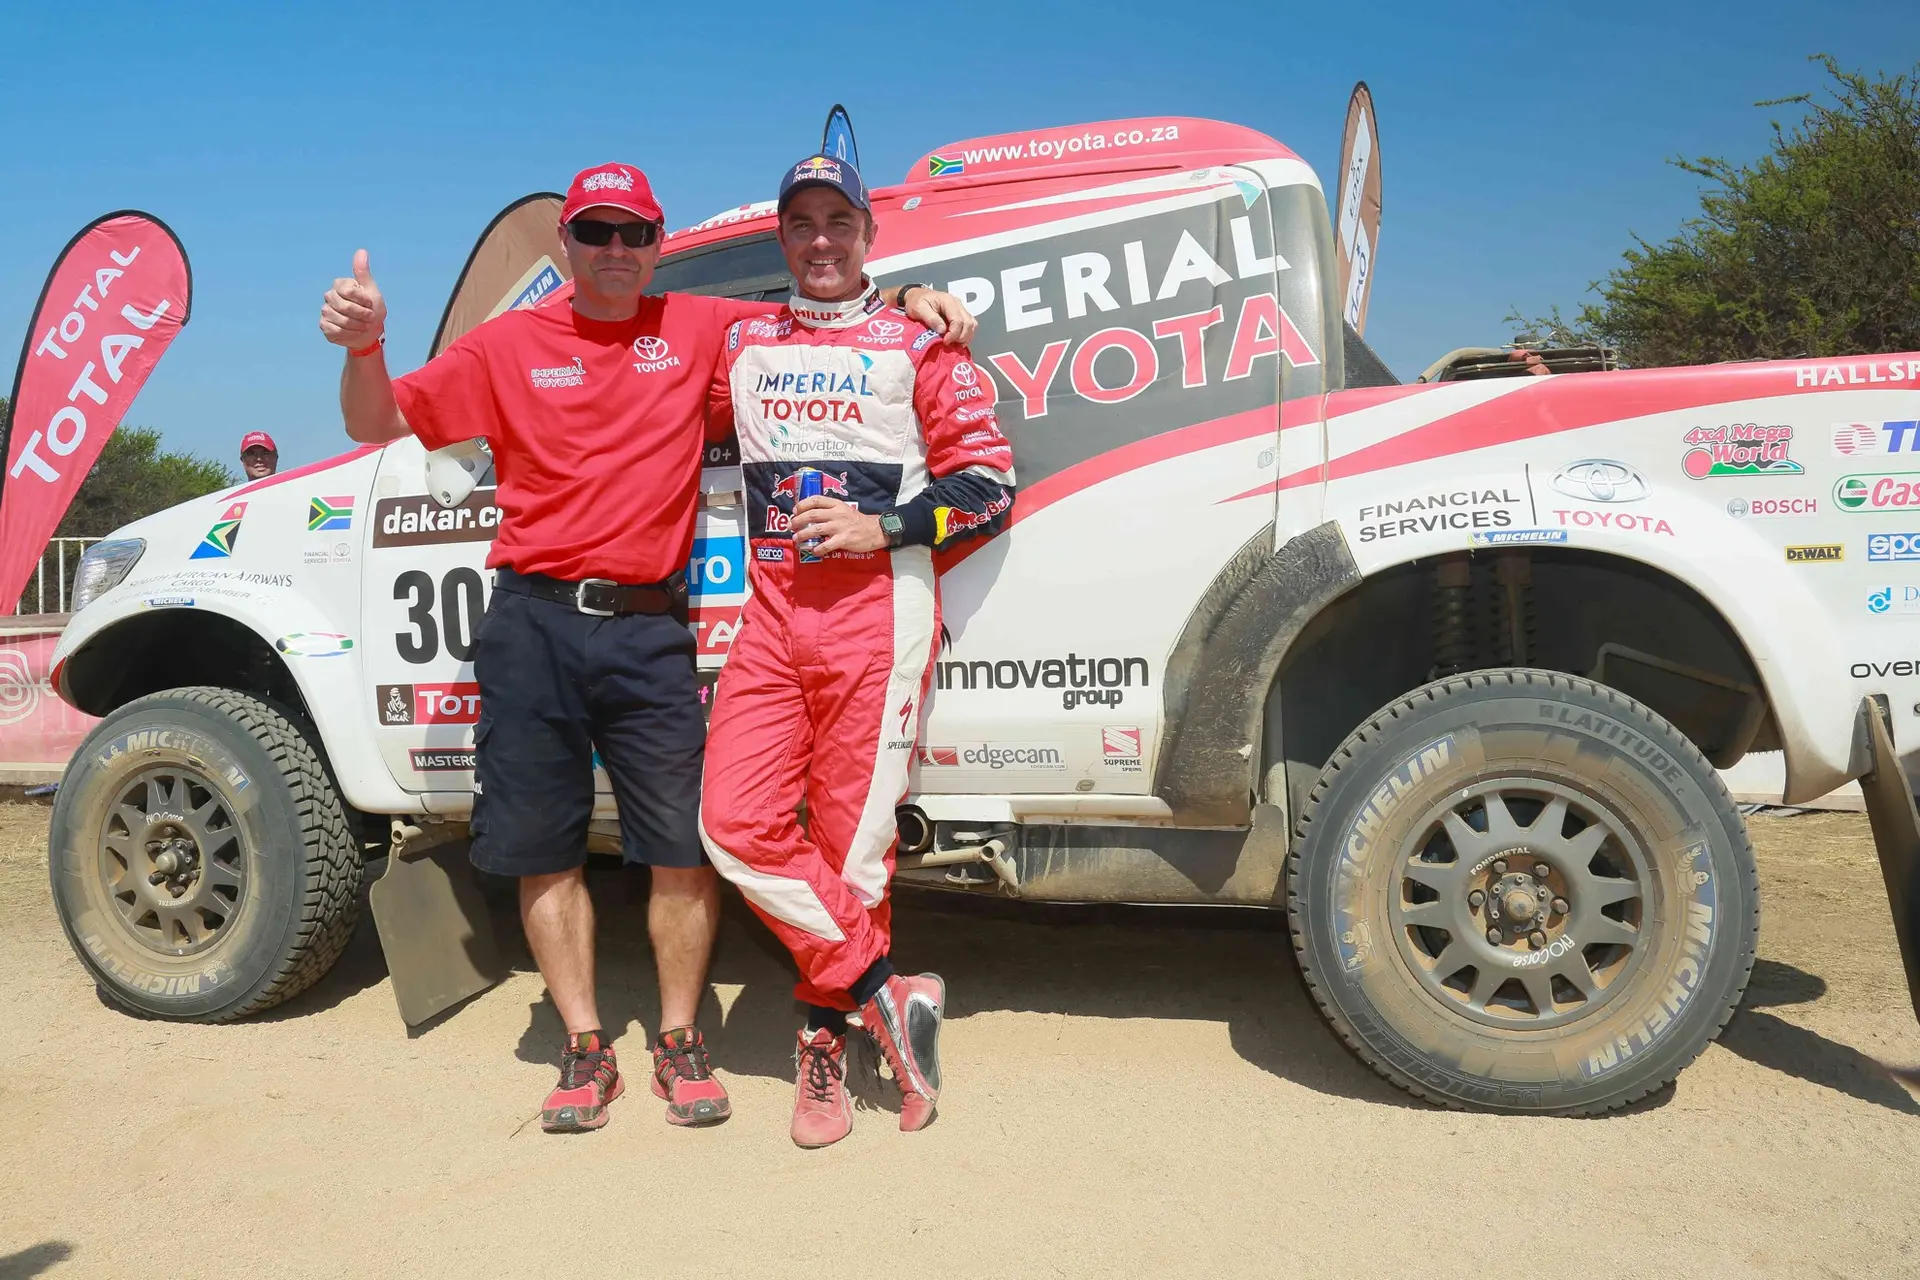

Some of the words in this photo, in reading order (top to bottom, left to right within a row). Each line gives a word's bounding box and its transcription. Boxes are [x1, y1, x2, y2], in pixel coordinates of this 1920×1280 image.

[963, 124, 1179, 165] www.toyota.co.za
[946, 215, 1292, 333] PERIAL
[36, 245, 141, 360] TOTAL
[794, 306, 844, 321] HILUX
[857, 335, 904, 345] TOYOTA
[633, 356, 681, 374] TOYOTA
[974, 292, 1321, 420] YOTA
[531, 364, 587, 379] IMPERIAL
[533, 376, 584, 388] TOYOTA
[755, 373, 873, 396] IMPERIAL
[10, 299, 171, 483] TOTAL
[761, 399, 864, 425] TOYOTA
[781, 439, 854, 453] innovation
[1684, 426, 1727, 444] 4x4
[1731, 424, 1792, 442] Mega
[1711, 442, 1788, 462] World
[1358, 488, 1520, 522] FINANCIAL
[1751, 498, 1817, 514] BOSCH
[383, 505, 503, 535] dakar.c
[765, 505, 795, 533] Re
[1358, 509, 1512, 543] SERVICES
[1552, 509, 1675, 537] TOYOTA
[1492, 530, 1563, 543] MICHELIN
[756, 548, 783, 558] sparco
[171, 579, 216, 587] CARGO
[233, 570, 292, 588] AIRWAYS
[152, 597, 192, 606] MICHELIN
[393, 567, 485, 664] 30
[937, 653, 1149, 690] innovation
[418, 690, 481, 716] TOT
[1063, 688, 1123, 710] group
[963, 743, 1060, 769] edgecam
[1557, 705, 1684, 784] LATITUDE
[1470, 847, 1531, 876] FONDMETAL
[85, 934, 201, 995] MICHELIN
[1588, 901, 1713, 1076] MICHELIN
